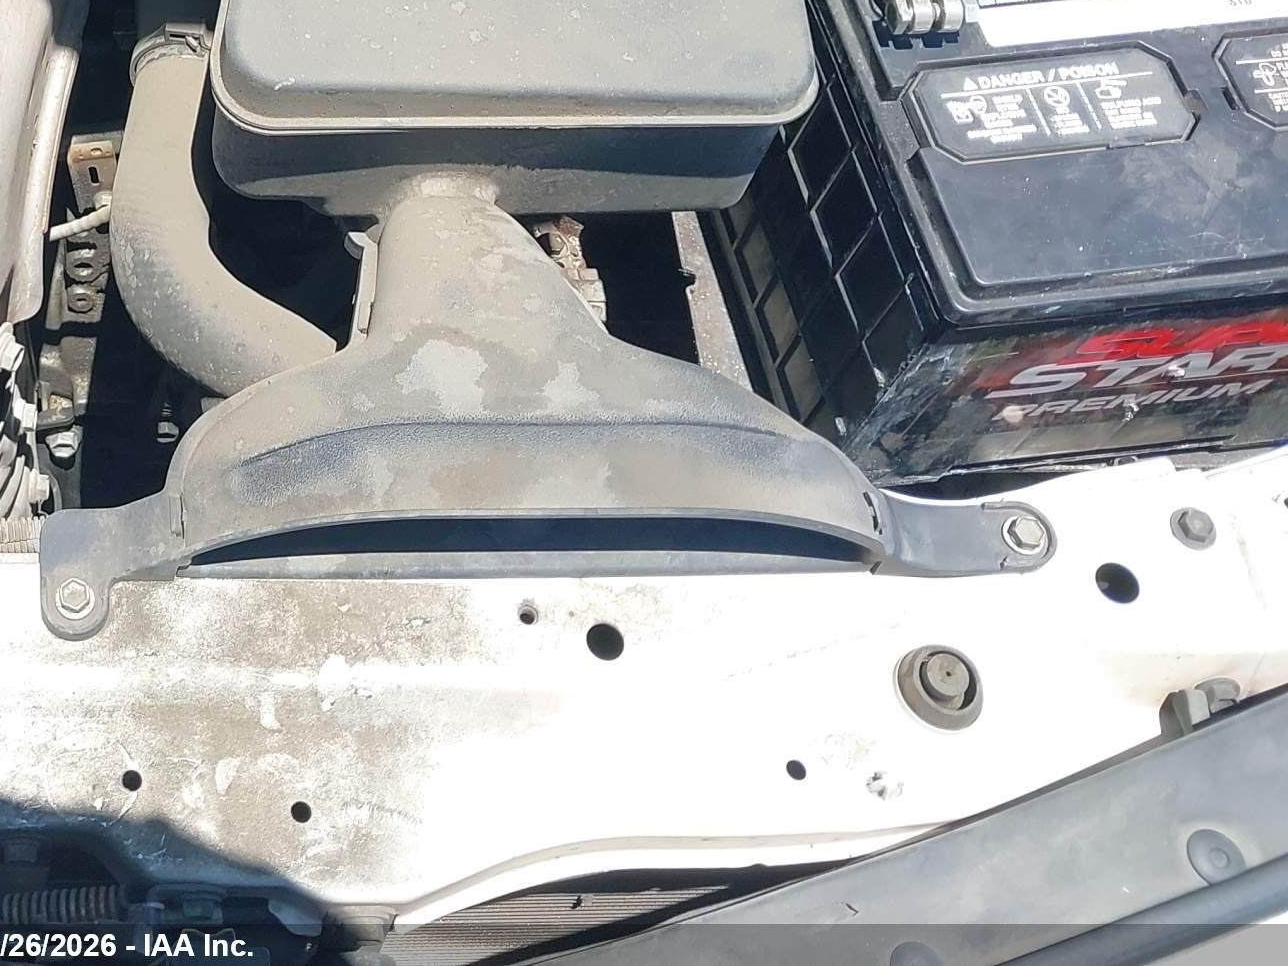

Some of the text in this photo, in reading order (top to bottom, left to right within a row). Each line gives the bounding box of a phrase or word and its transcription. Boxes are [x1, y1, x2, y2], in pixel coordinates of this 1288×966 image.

[977, 70, 1045, 91] DANGER
[1057, 61, 1121, 81] POISON
[991, 378, 1274, 422] PREMIUM
